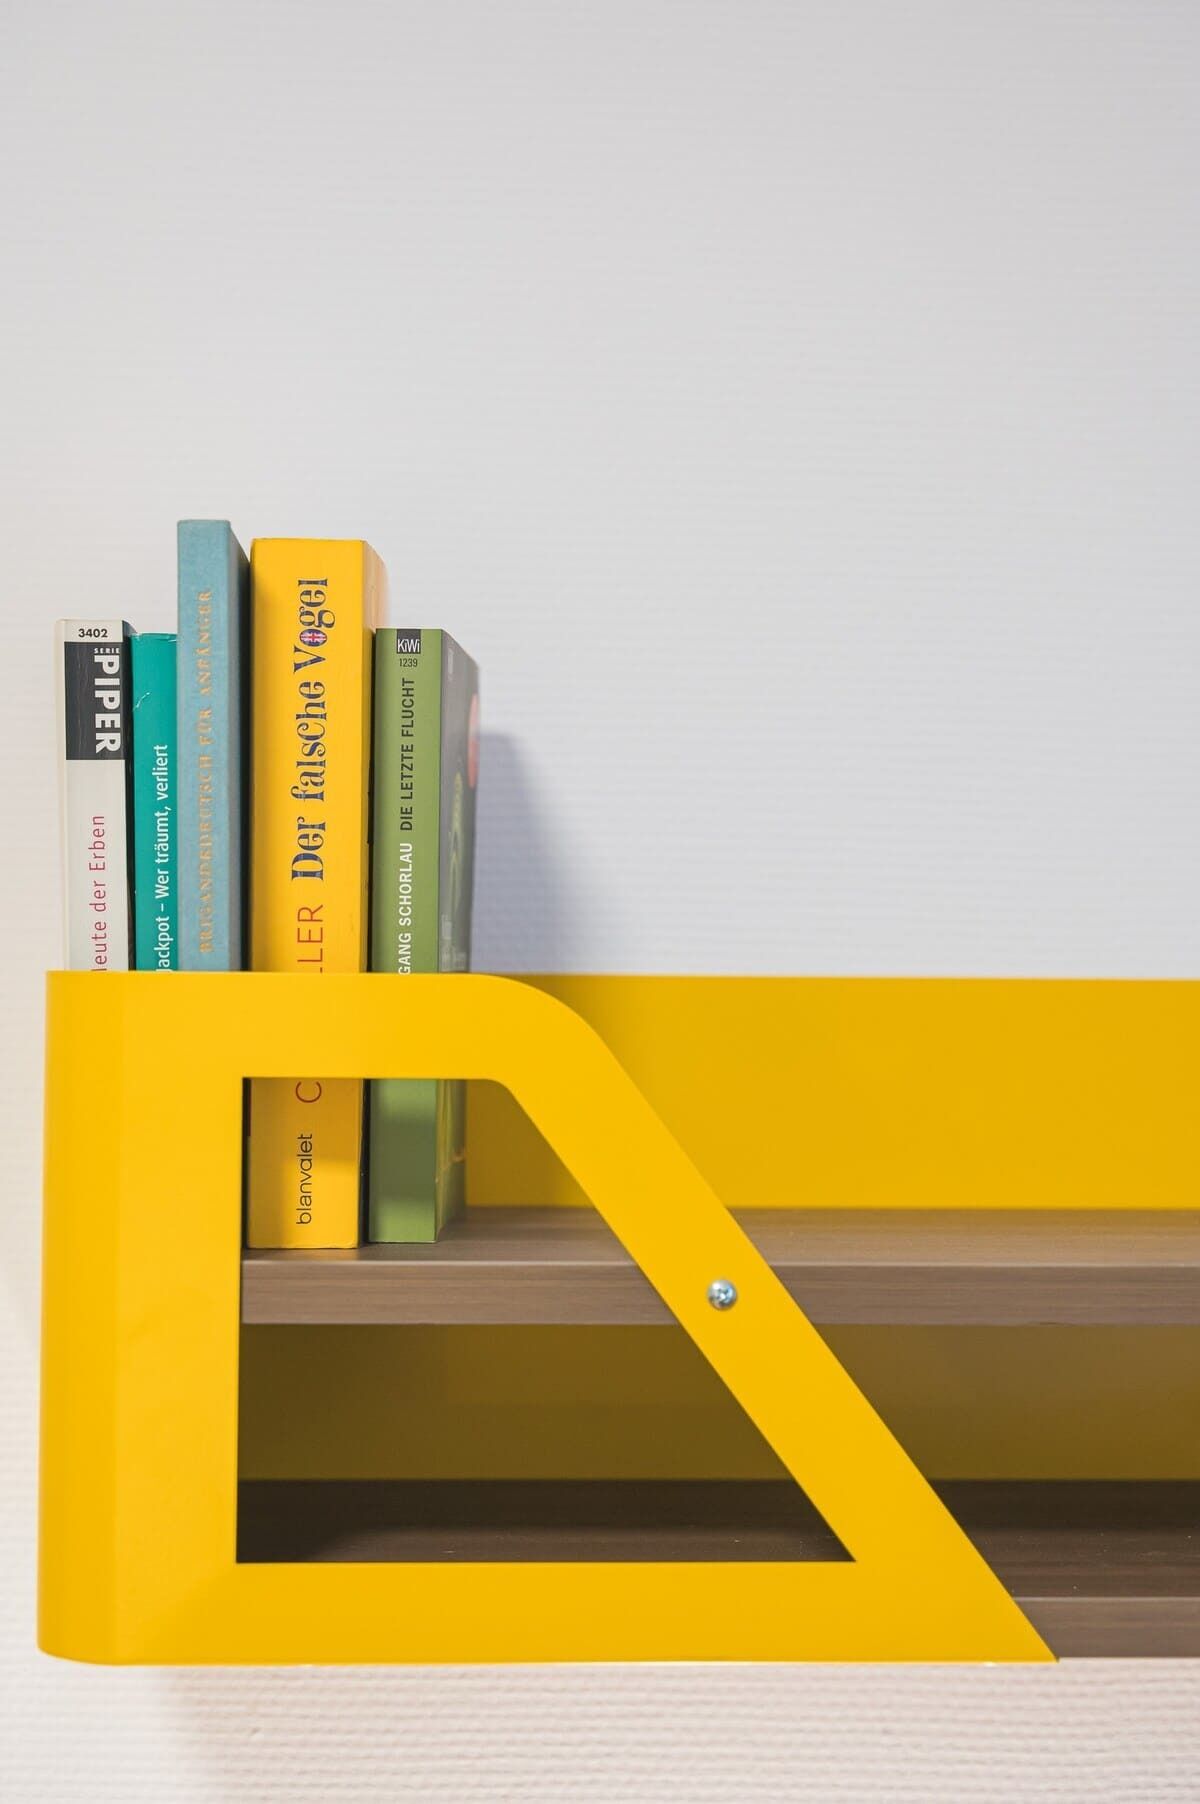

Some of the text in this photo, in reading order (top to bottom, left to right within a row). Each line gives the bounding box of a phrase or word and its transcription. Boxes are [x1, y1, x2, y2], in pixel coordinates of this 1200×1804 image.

[78, 628, 108, 638] 3402
[397, 639, 420, 653] KiWi
[399, 658, 418, 667] 1239
[94, 655, 121, 754] PIPER
[401, 678, 415, 737] FLUCHT
[151, 745, 168, 801] verliert
[290, 578, 336, 973] LER Der falsche Vogel
[400, 744, 414, 800] LETZTE
[154, 806, 172, 864] träumt,
[400, 806, 413, 831] DIE
[88, 816, 107, 971] eute der Erben
[155, 869, 169, 900] Wer
[399, 843, 413, 926] SCHORLAU
[296, 1133, 313, 1225] blanvalet
